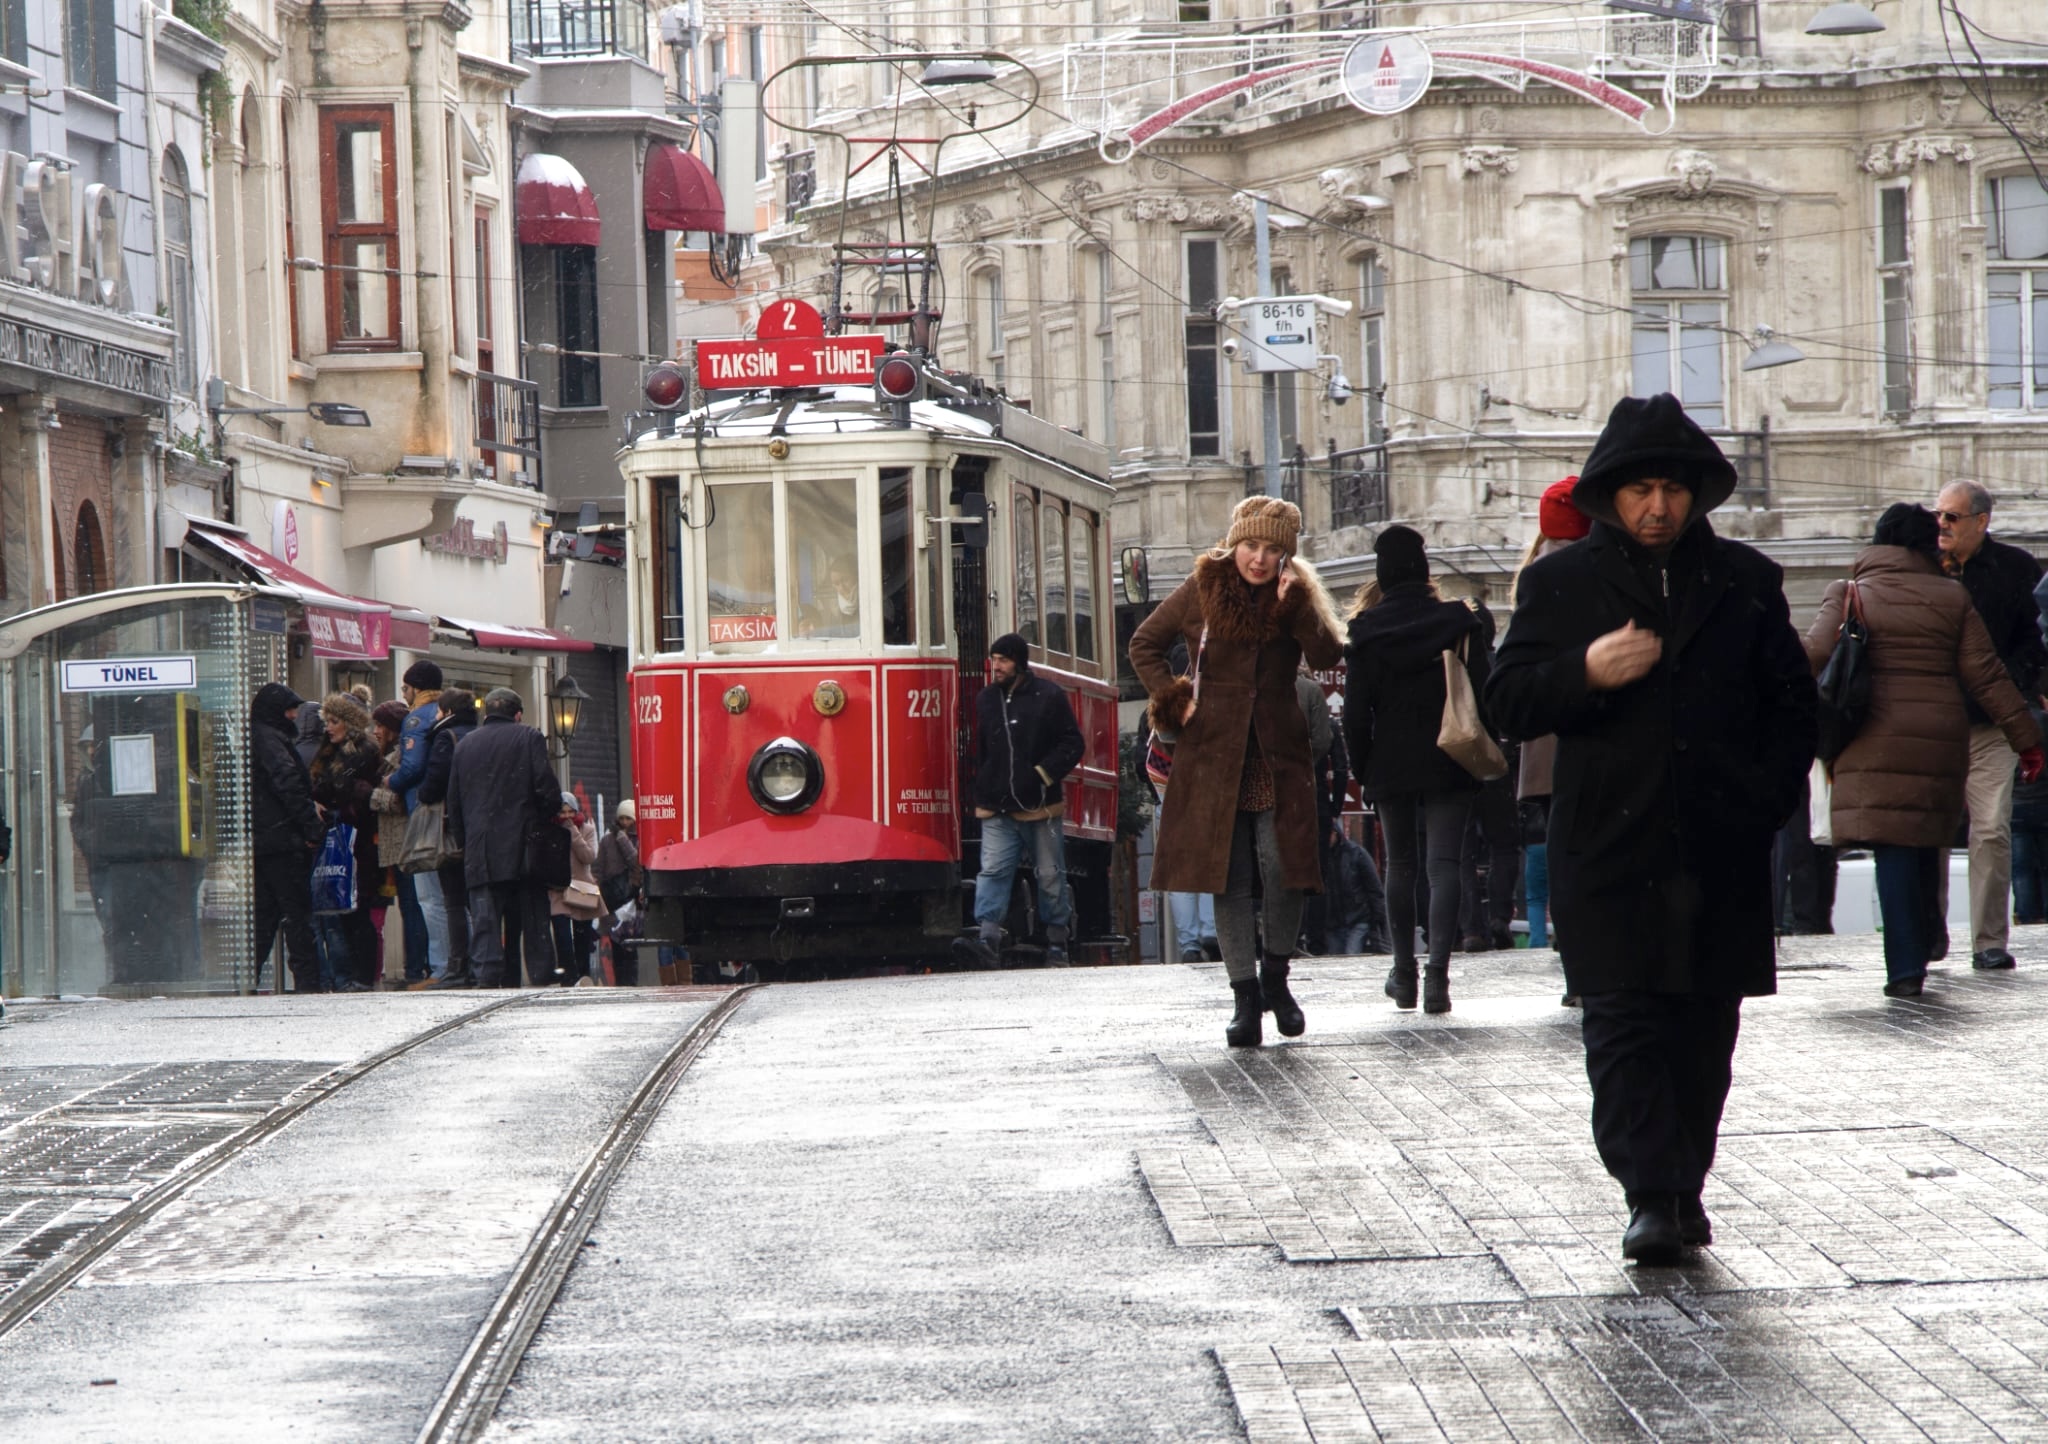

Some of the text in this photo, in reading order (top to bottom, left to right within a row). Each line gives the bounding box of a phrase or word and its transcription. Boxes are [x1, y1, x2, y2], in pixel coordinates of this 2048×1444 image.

[783, 302, 797, 331] 2
[1262, 304, 1305, 318] 86-16
[1275, 320, 1292, 331] f/h
[708, 347, 778, 379] TAKSİM
[812, 346, 875, 375] TÜNEL
[710, 619, 777, 640] TAKSİM
[100, 665, 158, 682] TÜNEL
[1312, 669, 1334, 685] SALT
[639, 695, 662, 724] 223
[907, 689, 941, 718] 223
[897, 803, 908, 814] VE
